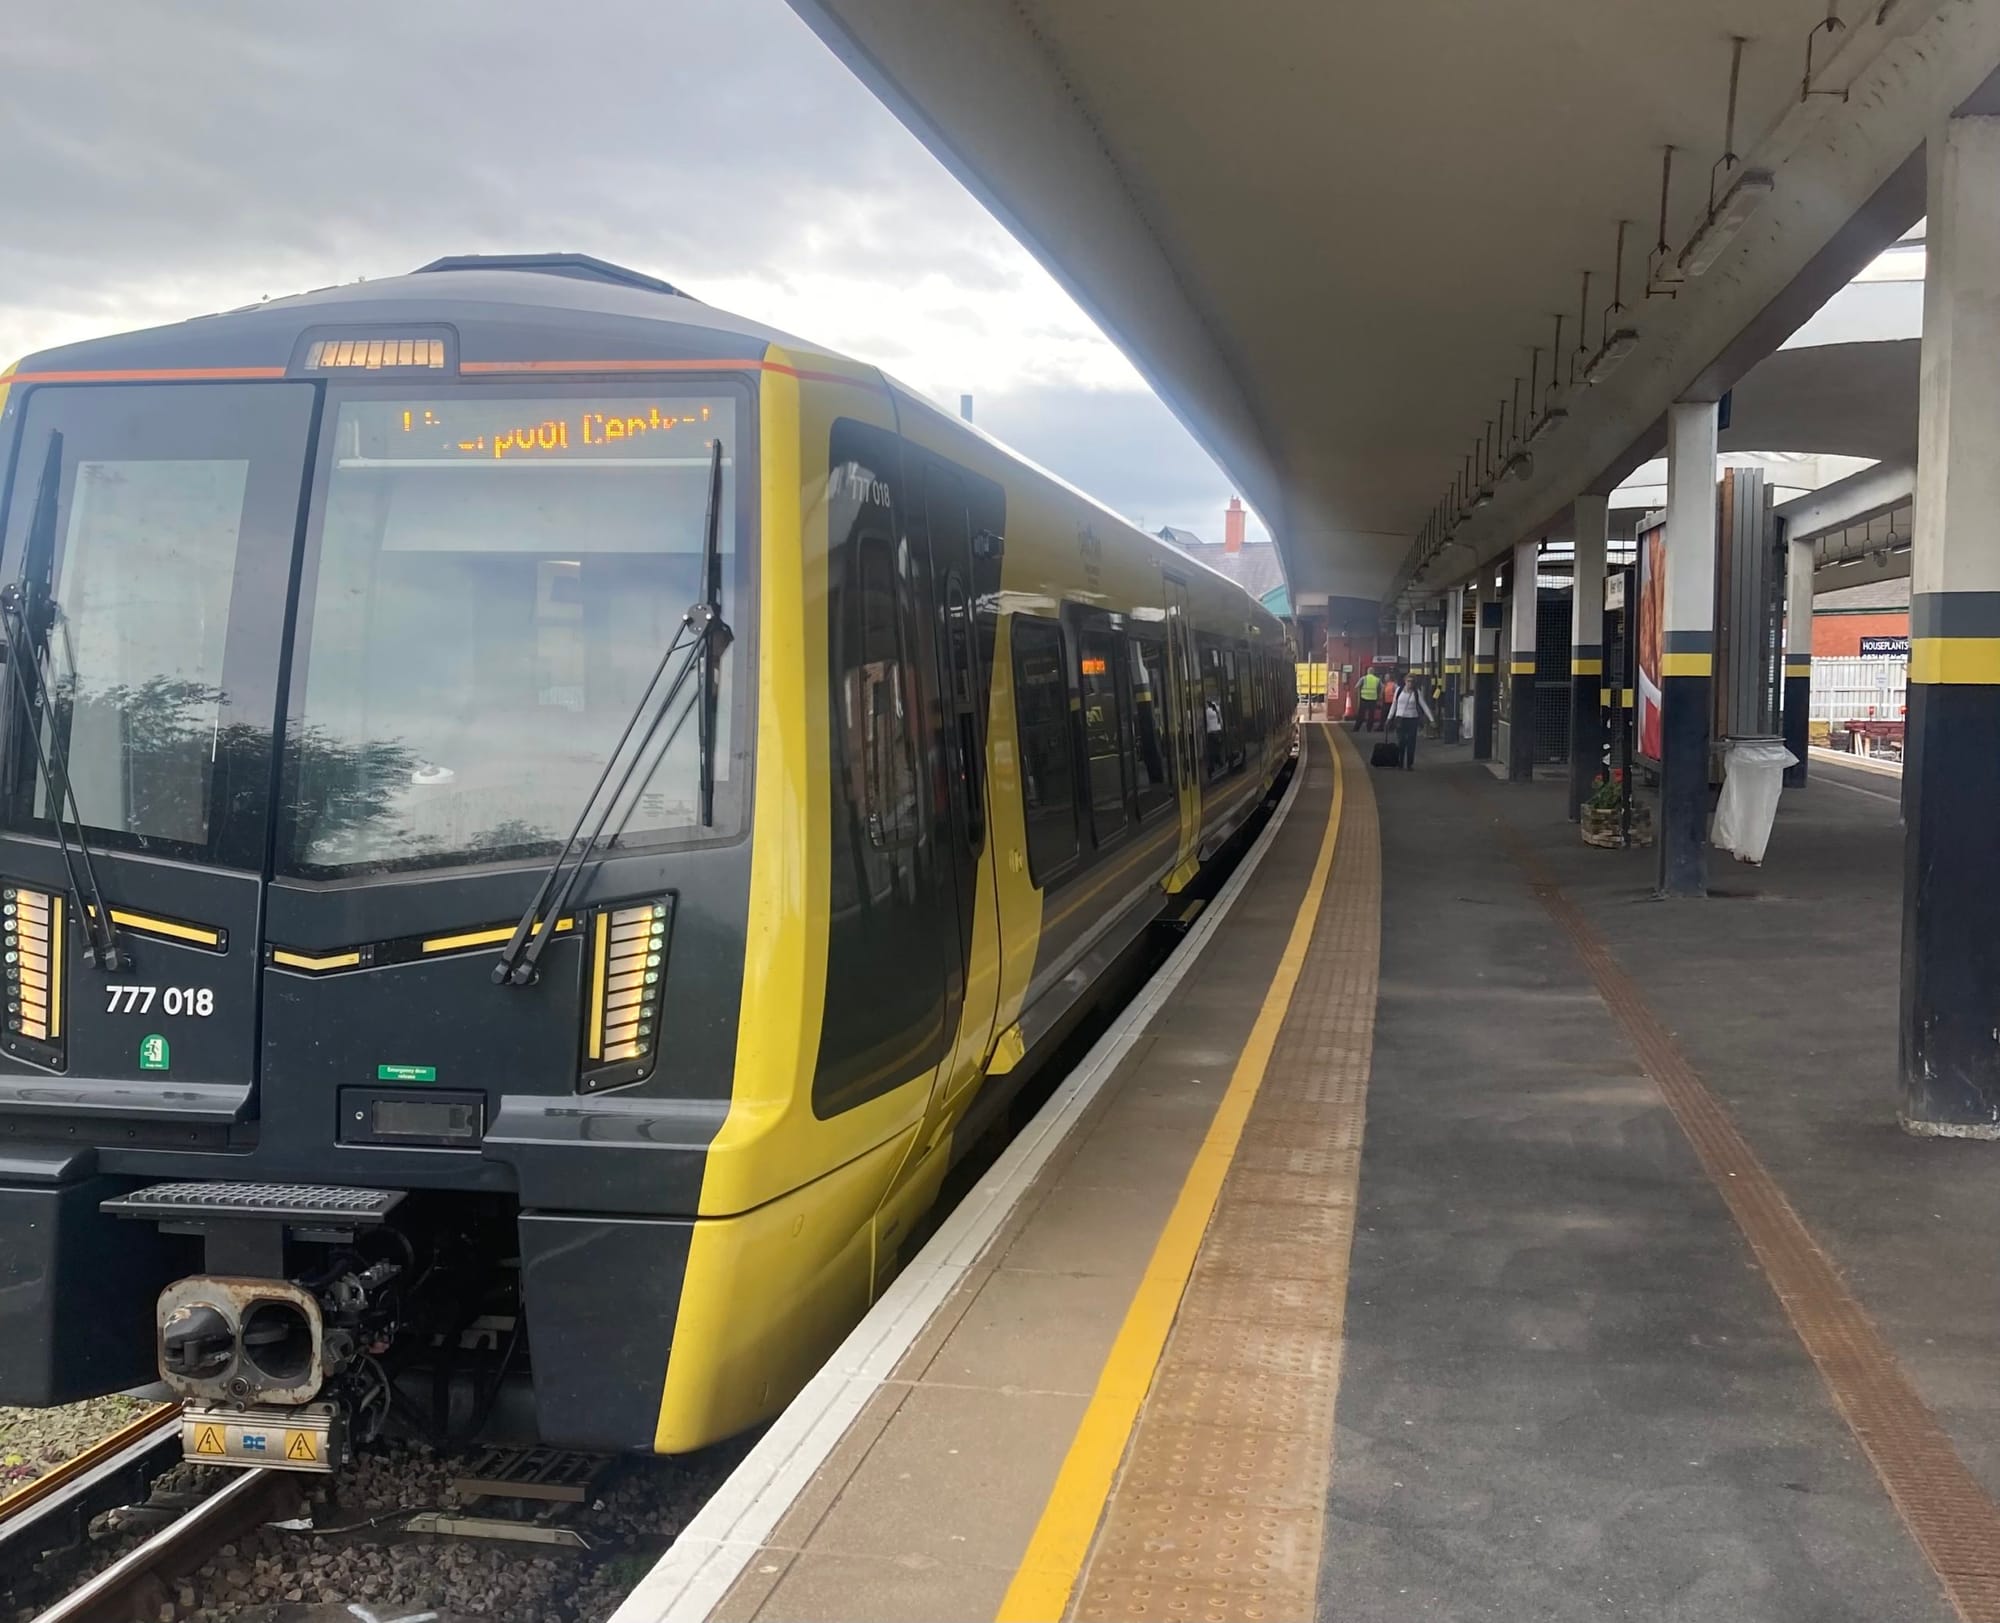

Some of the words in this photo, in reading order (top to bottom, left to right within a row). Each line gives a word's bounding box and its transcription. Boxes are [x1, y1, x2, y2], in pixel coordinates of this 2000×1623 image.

[583, 407, 713, 447] Centr
[872, 479, 891, 508] 018
[1862, 641, 1909, 650] HOUSEPLANTS
[106, 985, 157, 1014] 777
[163, 987, 214, 1016] 018
